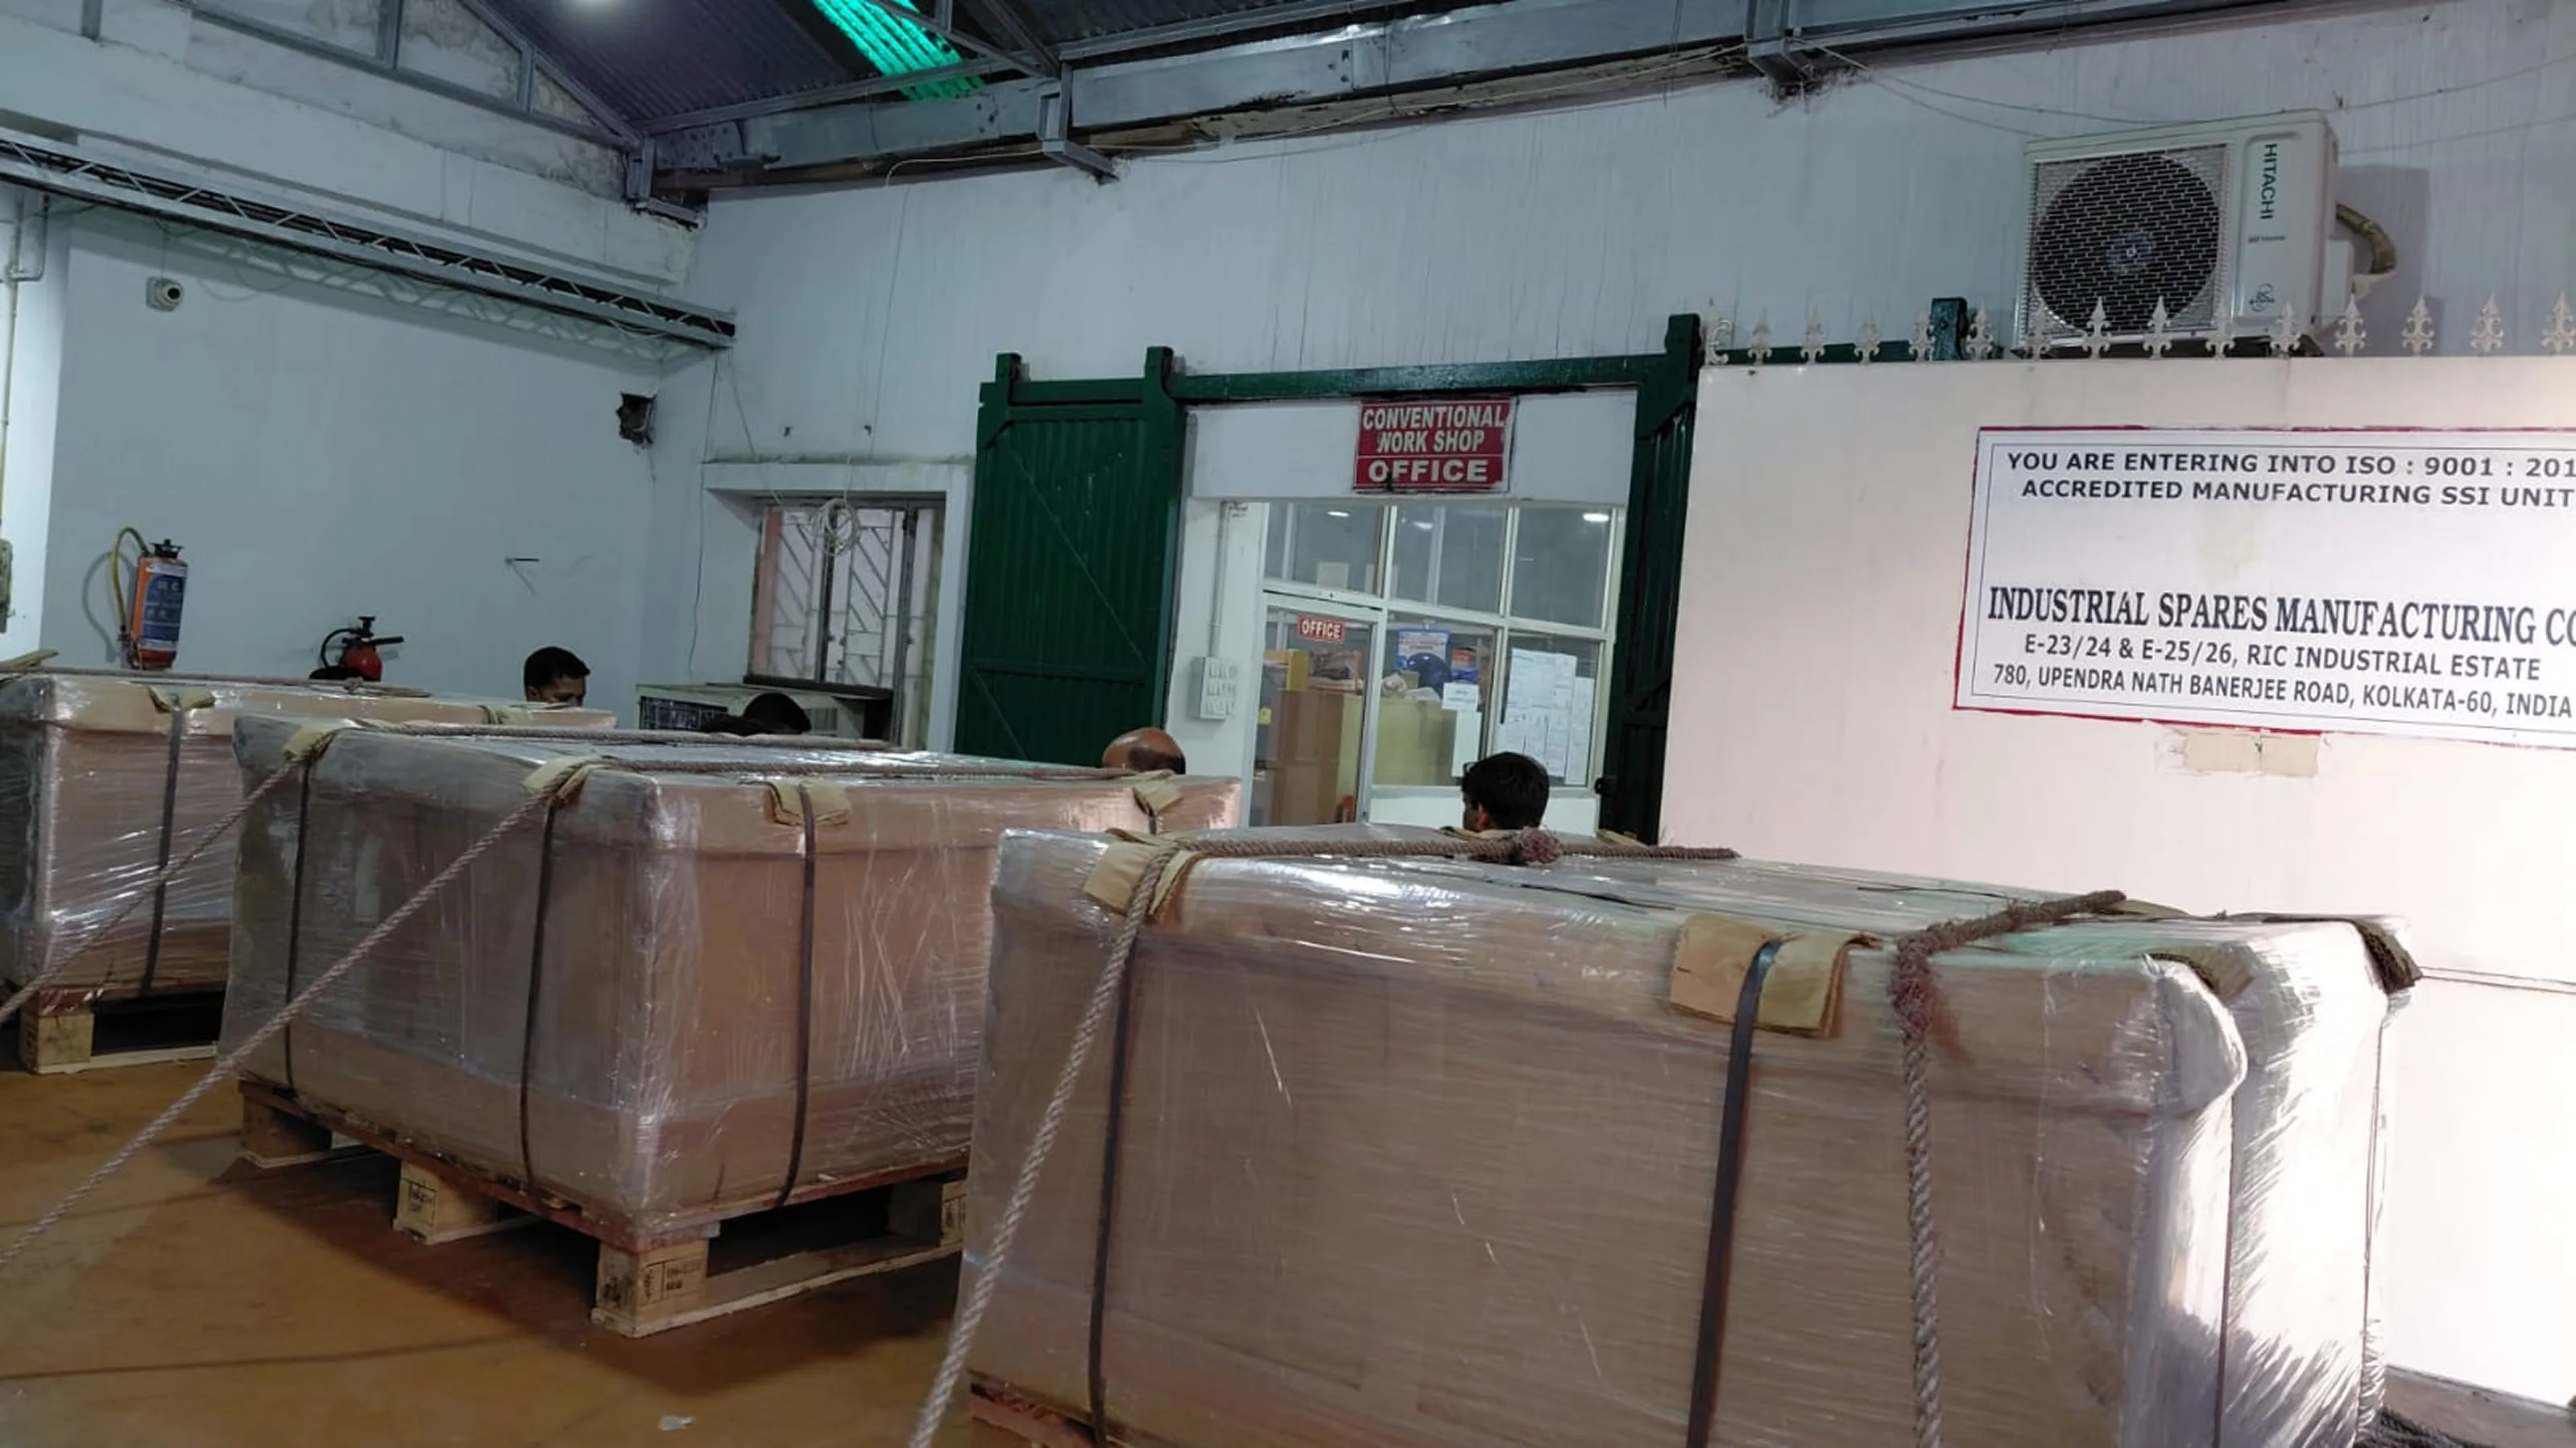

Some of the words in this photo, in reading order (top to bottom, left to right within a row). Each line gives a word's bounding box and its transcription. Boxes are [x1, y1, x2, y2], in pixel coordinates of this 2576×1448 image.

[2259, 143, 2277, 219] HITACHI
[1363, 405, 1505, 429] CONVENTIONAL
[1376, 431, 1429, 453] WORK
[1433, 429, 1485, 452] SHOP
[1369, 459, 1489, 482] OFFICE
[2008, 453, 2057, 471] YOU
[2066, 453, 2114, 470] ARE
[2124, 453, 2258, 472] ENTERING
[2267, 454, 2335, 474] INTO
[2346, 455, 2396, 474] ISO
[2425, 456, 2494, 476] 9001
[2022, 479, 2183, 499] ACCREDITED
[2192, 482, 2431, 504] MANUFACTURING
[2441, 486, 2490, 506] SSI
[2500, 487, 2575, 507] UNIT
[1987, 586, 2150, 626] INDUSTRIAL
[2158, 592, 2267, 631] SPARES
[2275, 597, 2536, 645] MANUFACTURING
[1302, 619, 1341, 639] OFFICE
[2025, 633, 2111, 660] E-23/24
[2118, 638, 2134, 659] &
[2142, 639, 2238, 668] E-25/26,
[2247, 645, 2287, 667] RIC
[2295, 647, 2441, 675] INDUSTRIAL
[2450, 654, 2541, 681] ESTATE
[1994, 664, 2031, 689] 780,
[2038, 668, 2125, 691] UPENDRA
[2132, 672, 2182, 694] NATH
[2189, 675, 2287, 701] BANERJEE
[2294, 681, 2354, 709] ROAD,
[2363, 685, 2498, 718] KOLKATA-60,
[2506, 693, 2573, 718] INDIA
